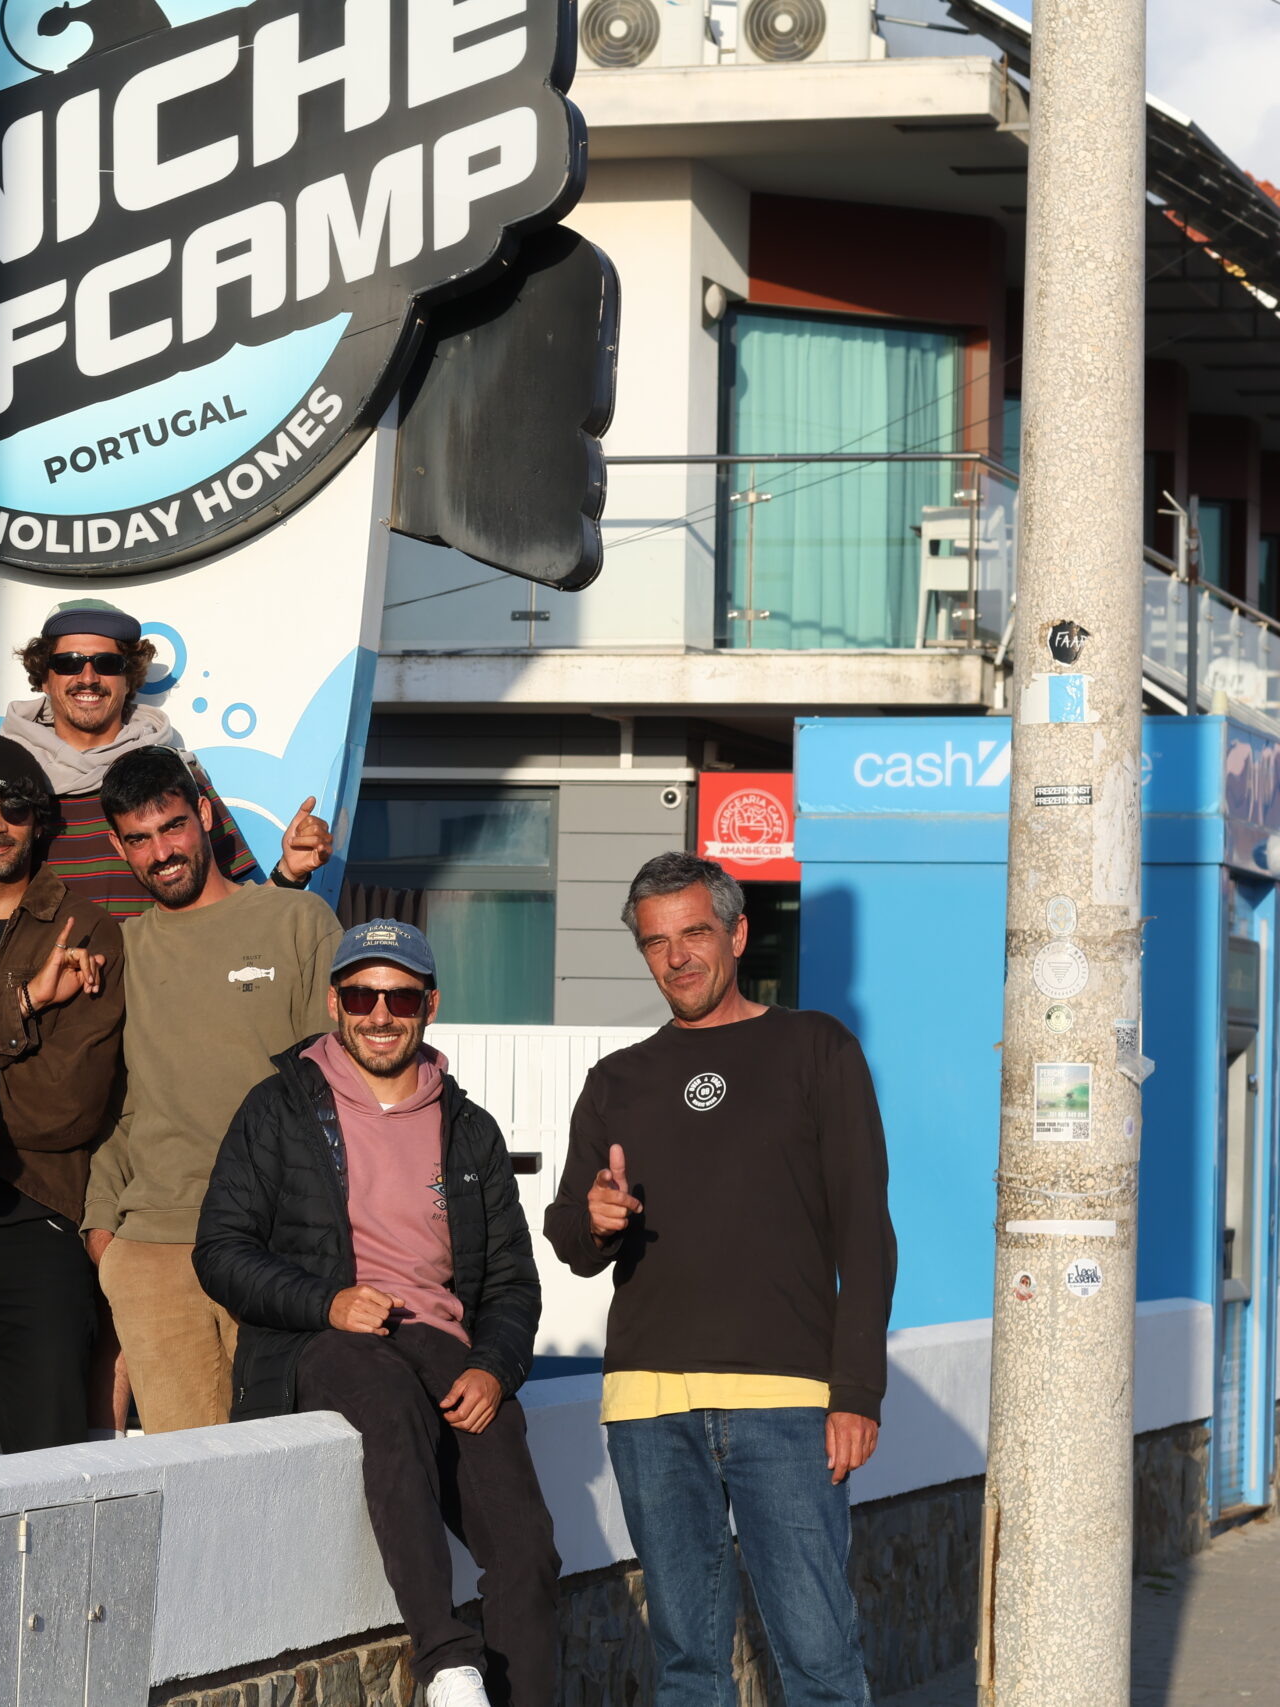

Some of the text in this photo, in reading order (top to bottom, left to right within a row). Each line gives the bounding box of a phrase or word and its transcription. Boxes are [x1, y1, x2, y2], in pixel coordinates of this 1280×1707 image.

[43, 394, 248, 484] PORTUGAL
[192, 385, 343, 523] HOMES
[719, 845, 782, 856] AMANHECER
